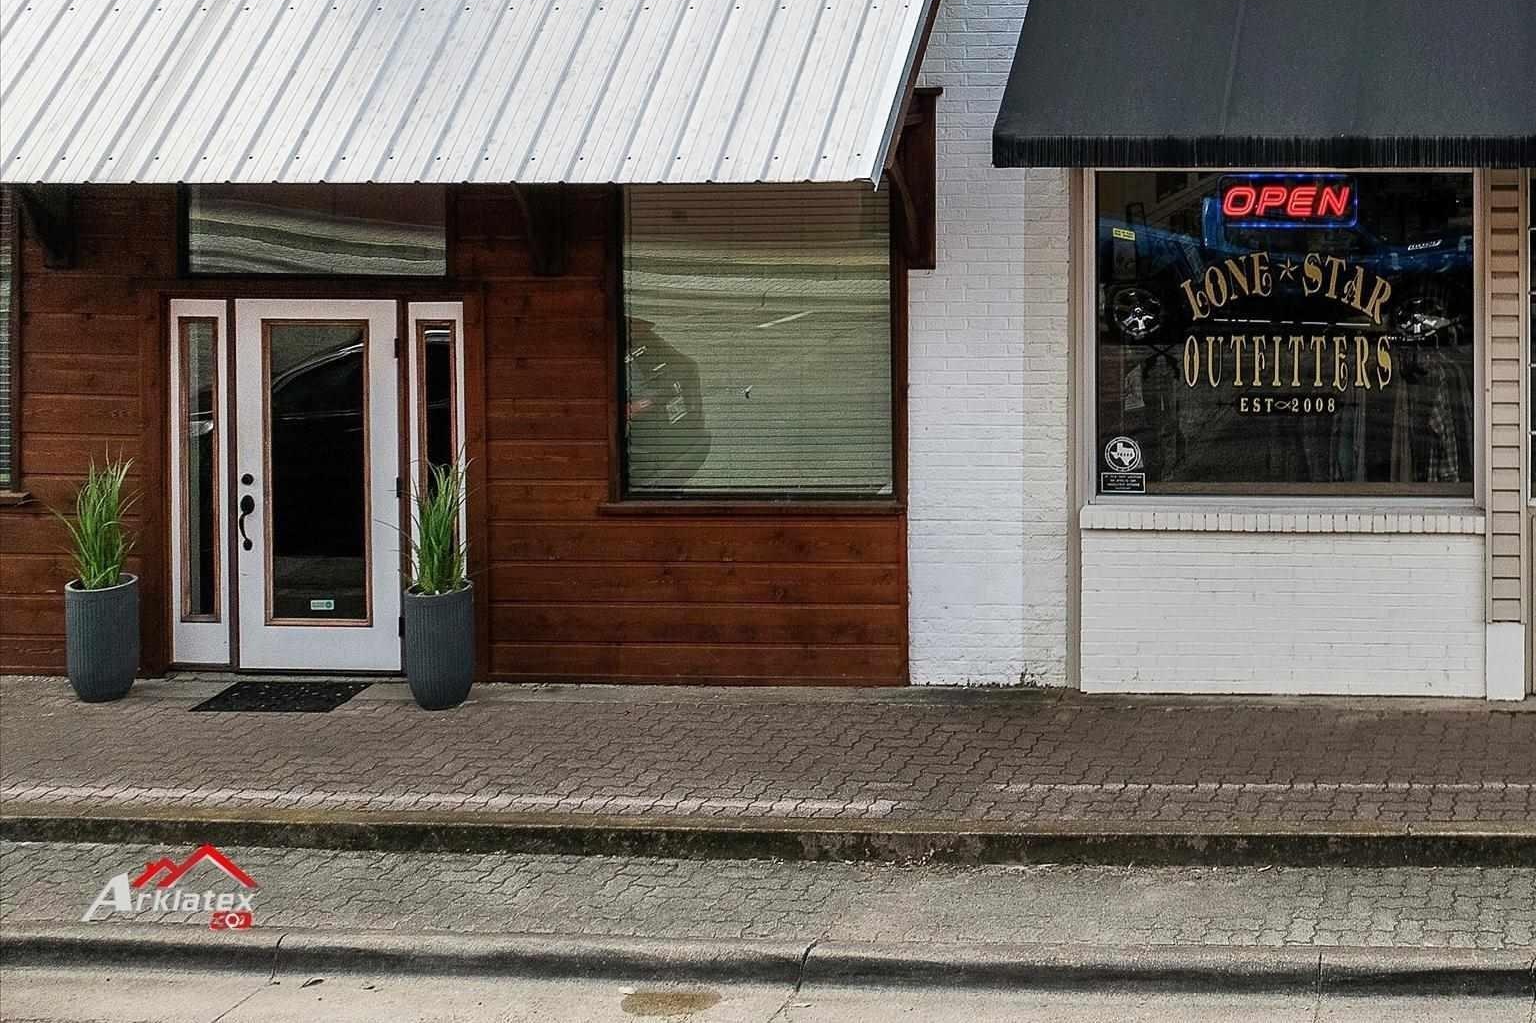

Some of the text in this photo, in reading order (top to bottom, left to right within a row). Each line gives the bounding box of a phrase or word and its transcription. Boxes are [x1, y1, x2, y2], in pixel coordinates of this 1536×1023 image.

[1222, 185, 1352, 218] OPEN
[1179, 252, 1393, 325] LONE STAR
[1182, 334, 1394, 392] OUTFITTERS
[1240, 397, 1336, 414] EST 2008
